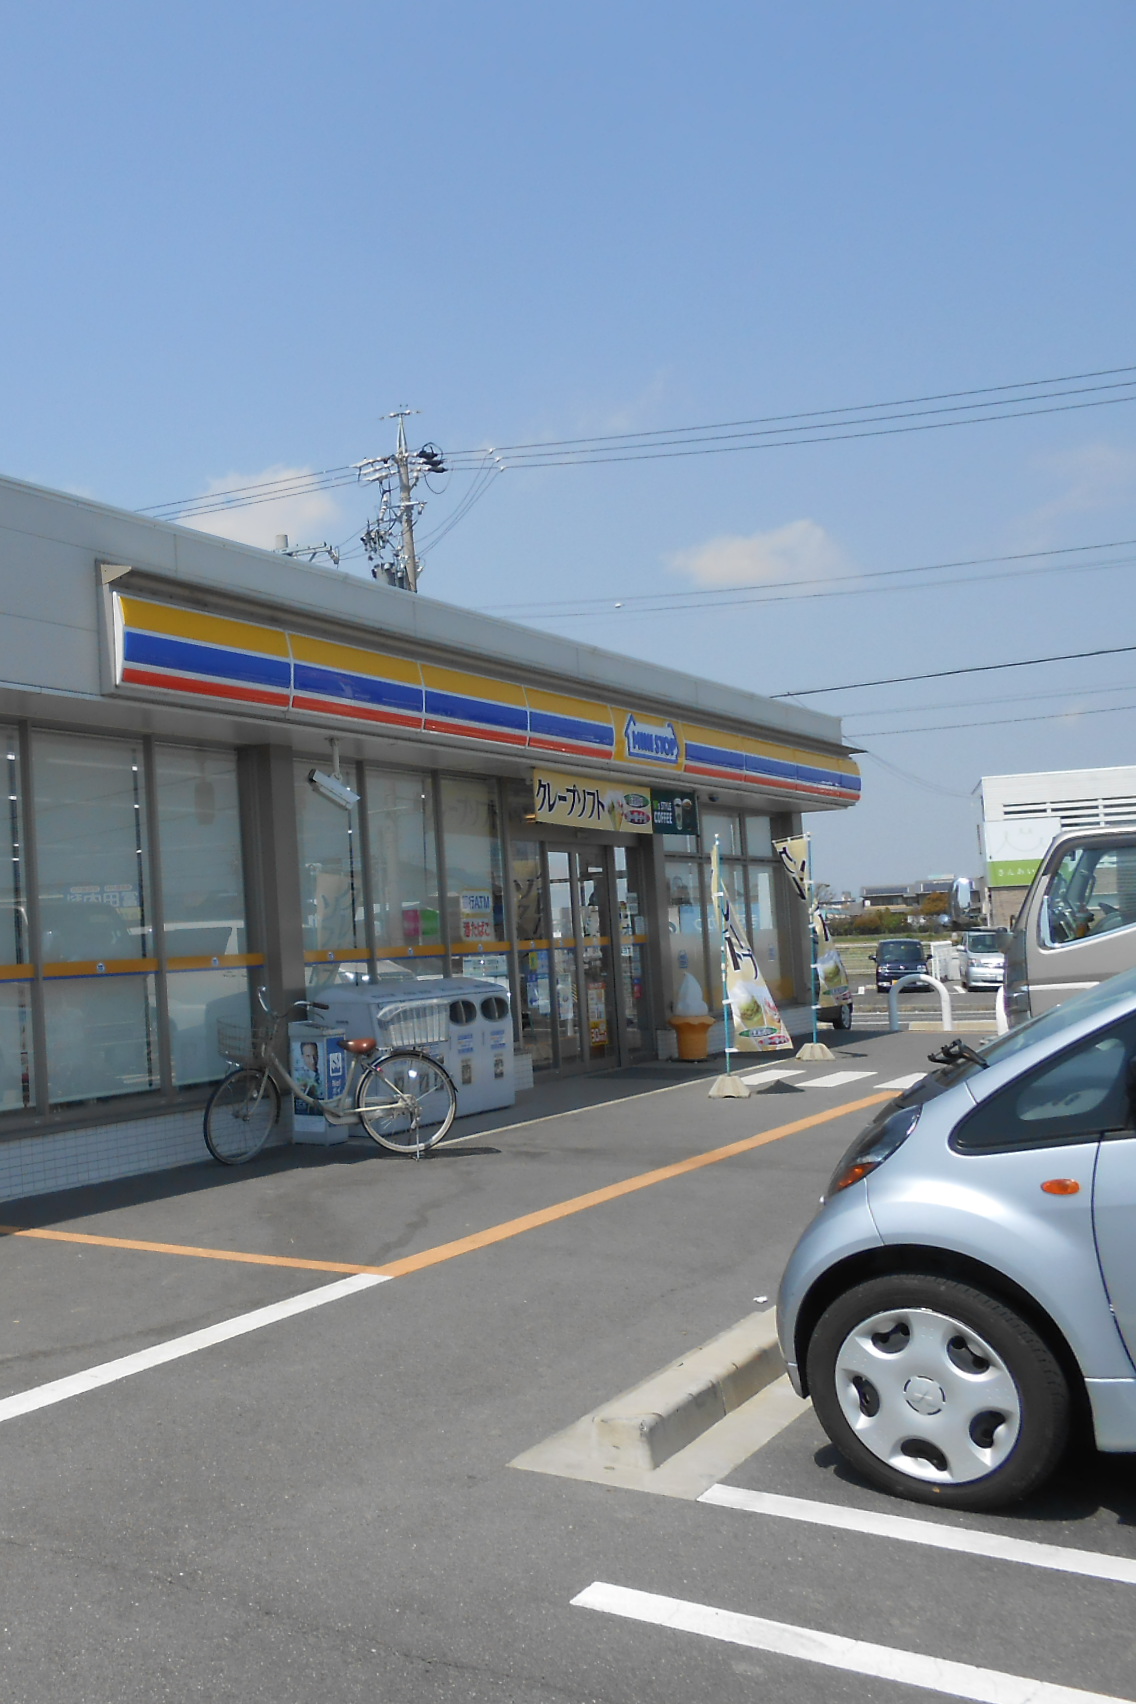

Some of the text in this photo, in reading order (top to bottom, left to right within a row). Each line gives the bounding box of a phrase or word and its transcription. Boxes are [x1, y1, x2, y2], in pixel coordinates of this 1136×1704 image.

[632, 731, 654, 753] MINI
[536, 779, 605, 820] クレープソフト
